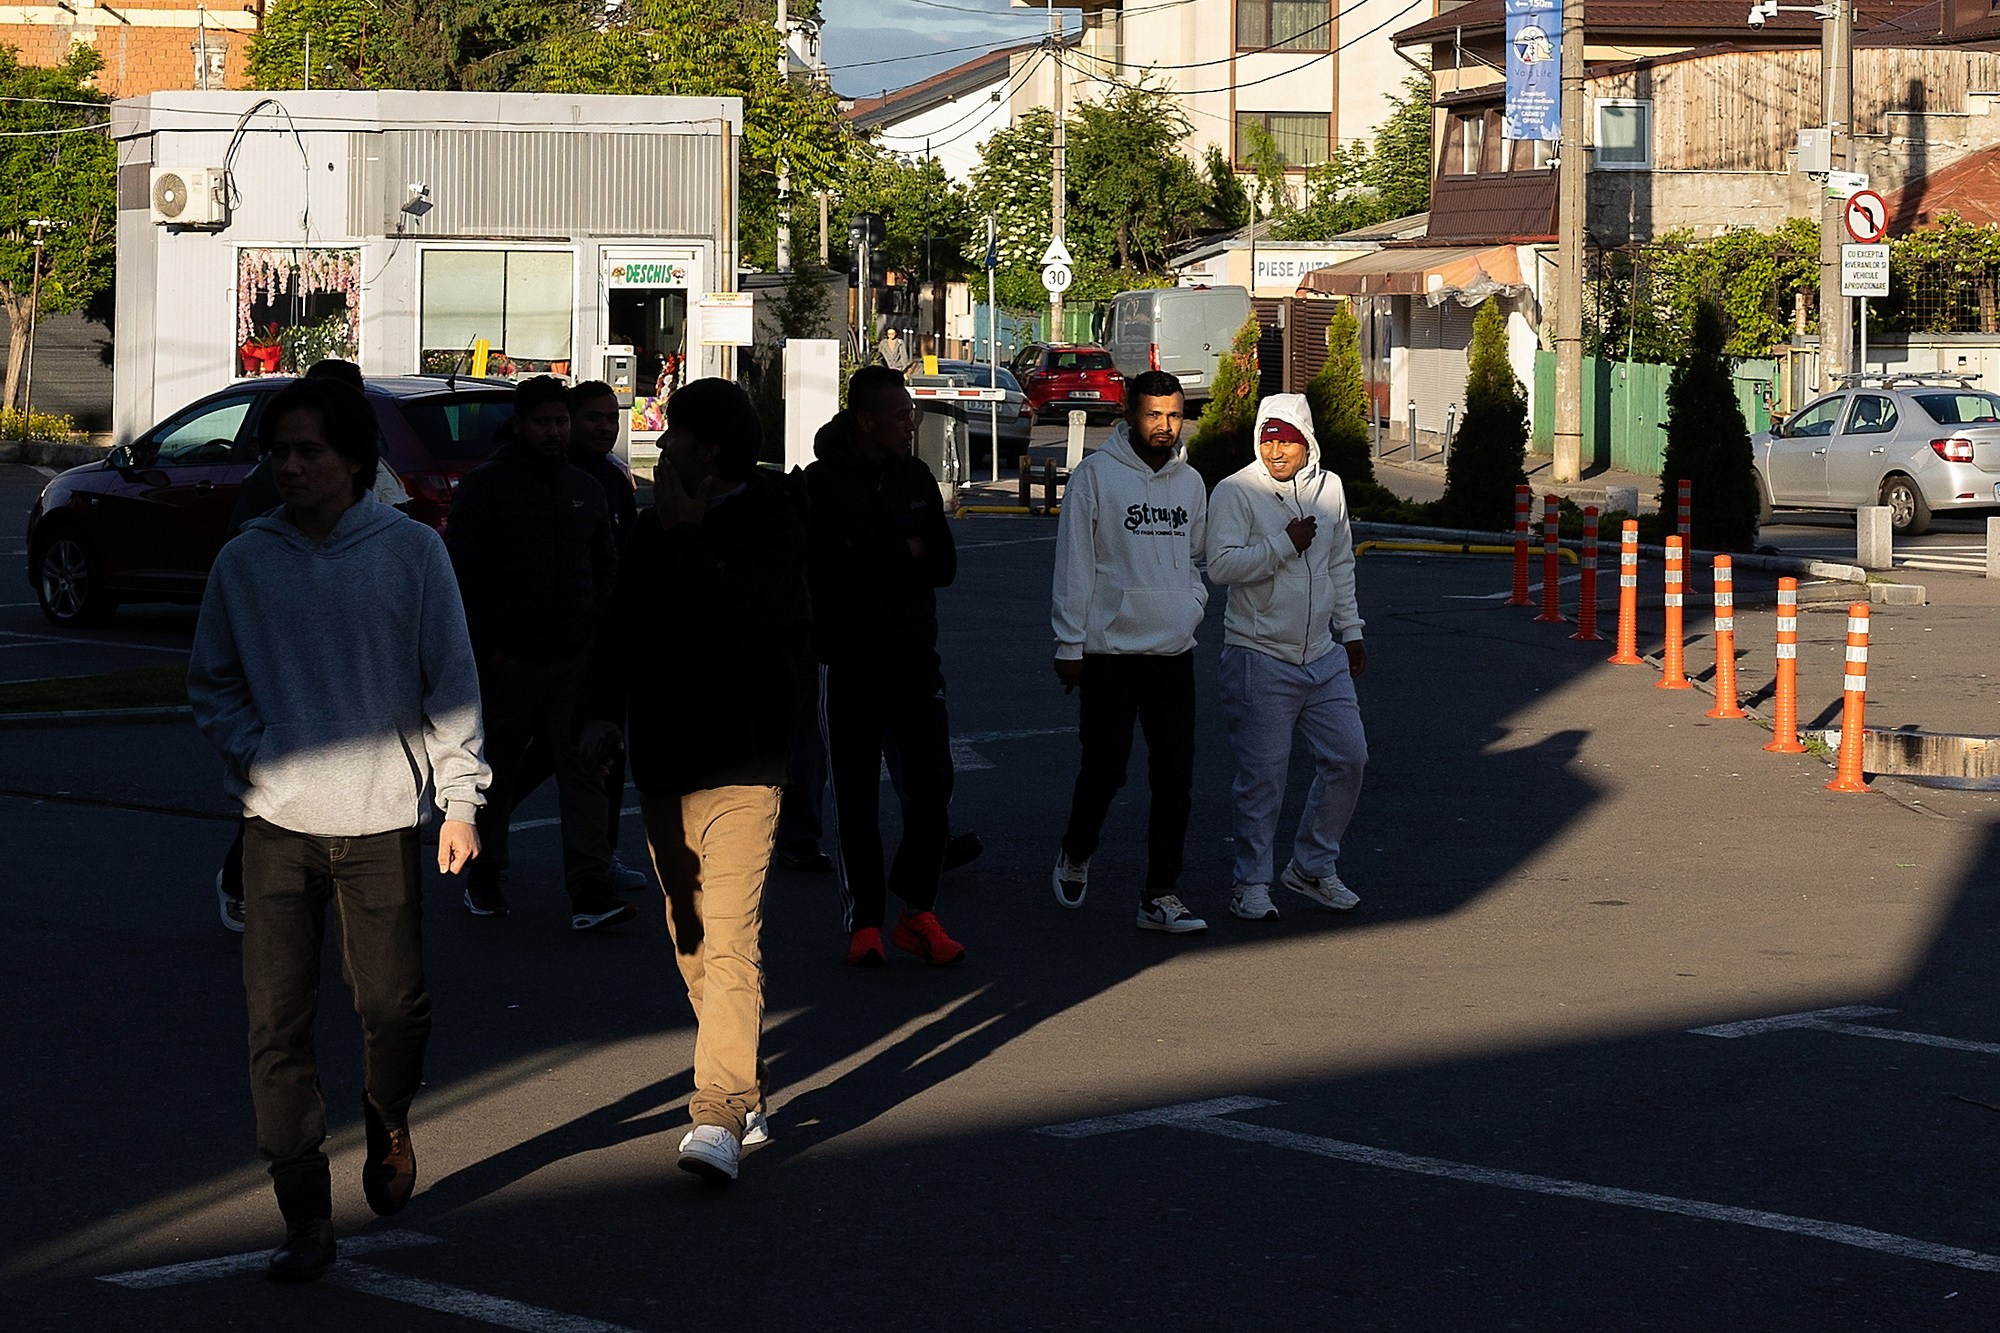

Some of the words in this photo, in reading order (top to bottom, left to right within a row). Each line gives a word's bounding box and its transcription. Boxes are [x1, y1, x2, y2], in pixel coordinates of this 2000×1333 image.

[625, 264, 673, 283] DESCHIS
[1258, 261, 1294, 276] PIESE
[1048, 270, 1065, 285] 30
[1844, 282, 1886, 290] APROVIZIONARE
